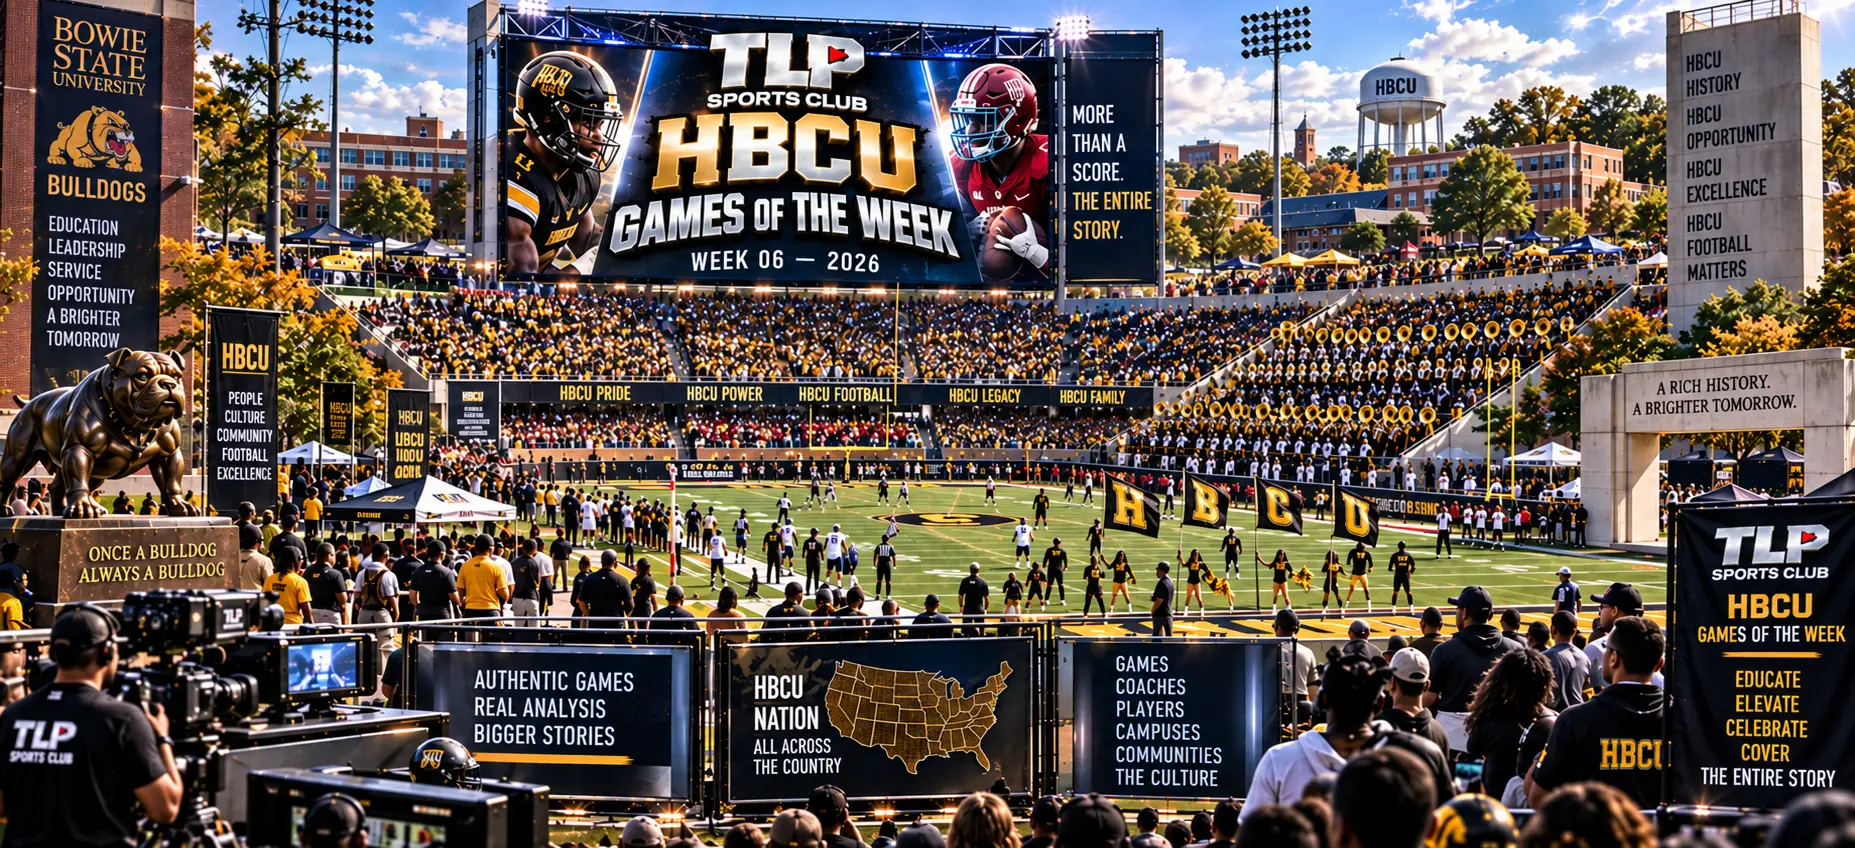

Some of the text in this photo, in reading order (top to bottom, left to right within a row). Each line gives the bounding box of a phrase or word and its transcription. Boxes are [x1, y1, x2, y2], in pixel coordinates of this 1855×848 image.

[53, 16, 147, 54] BOWIE
[53, 44, 146, 80] STATE
[710, 33, 864, 89] TLP
[1687, 50, 1721, 72] HBCU
[53, 72, 146, 96] UNIVERSITY
[1376, 78, 1416, 95] HBCU
[1687, 72, 1741, 97] HISTORY
[707, 92, 867, 112] SPORTS CLUB
[1073, 105, 1114, 123] MORE
[1687, 104, 1721, 125] HBCU
[1073, 134, 1126, 152] THAN A
[1687, 122, 1776, 149] OPPORTUNITY
[652, 112, 916, 193] HBCU
[1073, 162, 1123, 181] SCORE.
[1687, 158, 1721, 179] HBCU
[48, 174, 145, 202] BULLDOGS
[1688, 178, 1767, 203] EXCELLENCE
[1073, 191, 1152, 210] THE ENTIRE
[49, 216, 118, 235] EDUCATION
[609, 192, 744, 255] GAMES
[753, 198, 786, 229] OF
[792, 192, 847, 233] THE
[857, 196, 961, 258] WEEK
[1074, 221, 1122, 239] STORY.
[1688, 212, 1721, 232] HBCU
[49, 238, 125, 258] LEADERSHIP
[1688, 235, 1752, 256] FOOTBALL
[48, 261, 101, 279] SERVICE
[692, 250, 750, 271] WEEK
[759, 250, 783, 268] 06
[828, 252, 879, 272] 2026
[1688, 260, 1746, 281] MATTERS
[48, 285, 134, 304] OPPORTUNITY
[47, 308, 120, 326] A BRIGHTER
[47, 331, 119, 348] TOMORROW
[223, 343, 269, 370] HBCU
[560, 386, 630, 400] HBCU PRIDE
[688, 386, 762, 401] HBCU POWER
[800, 387, 892, 402] HBCU FOOTBALL
[1657, 375, 1770, 395] A RICH HISTORY.
[229, 392, 263, 405] PEOPLE
[950, 388, 1020, 403] HBCU LEGACY
[1060, 390, 1125, 404] HBCU FAMILY
[1633, 395, 1796, 415] A BRIGHTER TOMORROW.
[225, 410, 265, 423] CULTURE
[399, 410, 422, 424] HBCU
[217, 428, 272, 442] COMMUNITY
[223, 448, 268, 461] FOOTBALL
[218, 467, 272, 480] EXCELLENCE
[1112, 479, 1371, 538] H B C U
[89, 543, 216, 561] ONCE A BULLDOG
[1714, 524, 1831, 565] TLP
[79, 561, 225, 583] ALWAYS A BULLDOG
[1712, 567, 1828, 580] SPORTS CLUB
[1729, 593, 1812, 618] HBCU
[223, 608, 243, 624] TLP
[1698, 626, 1845, 642] GAMES OF THE WEEK
[1116, 656, 1168, 672] GAMES
[474, 670, 633, 692] AUTHENTIC GAMES
[755, 675, 803, 699] HBCU
[1116, 678, 1185, 695] COACHES
[1736, 671, 1800, 688] EDUCATE
[475, 697, 605, 718] REAL ANALYSIS
[1117, 701, 1184, 717] PLAYERS
[1736, 695, 1799, 712] ELEVATE
[755, 706, 818, 730] NATION
[13, 719, 77, 750] TLP
[475, 724, 614, 746] BIGGER STORIES
[1117, 723, 1200, 740] CAMPUSES
[1726, 719, 1807, 737] CELEBRATE
[754, 738, 831, 754] ALL ACROSS
[1116, 746, 1221, 764] COMMUNITIES
[1742, 744, 1789, 762] COVER
[9, 749, 74, 765] SPORTS CLUB
[753, 758, 841, 774] THE COUNTRY
[1116, 769, 1218, 786] THE CULTURE
[1701, 767, 1835, 787] THE ENTIRE STORY
